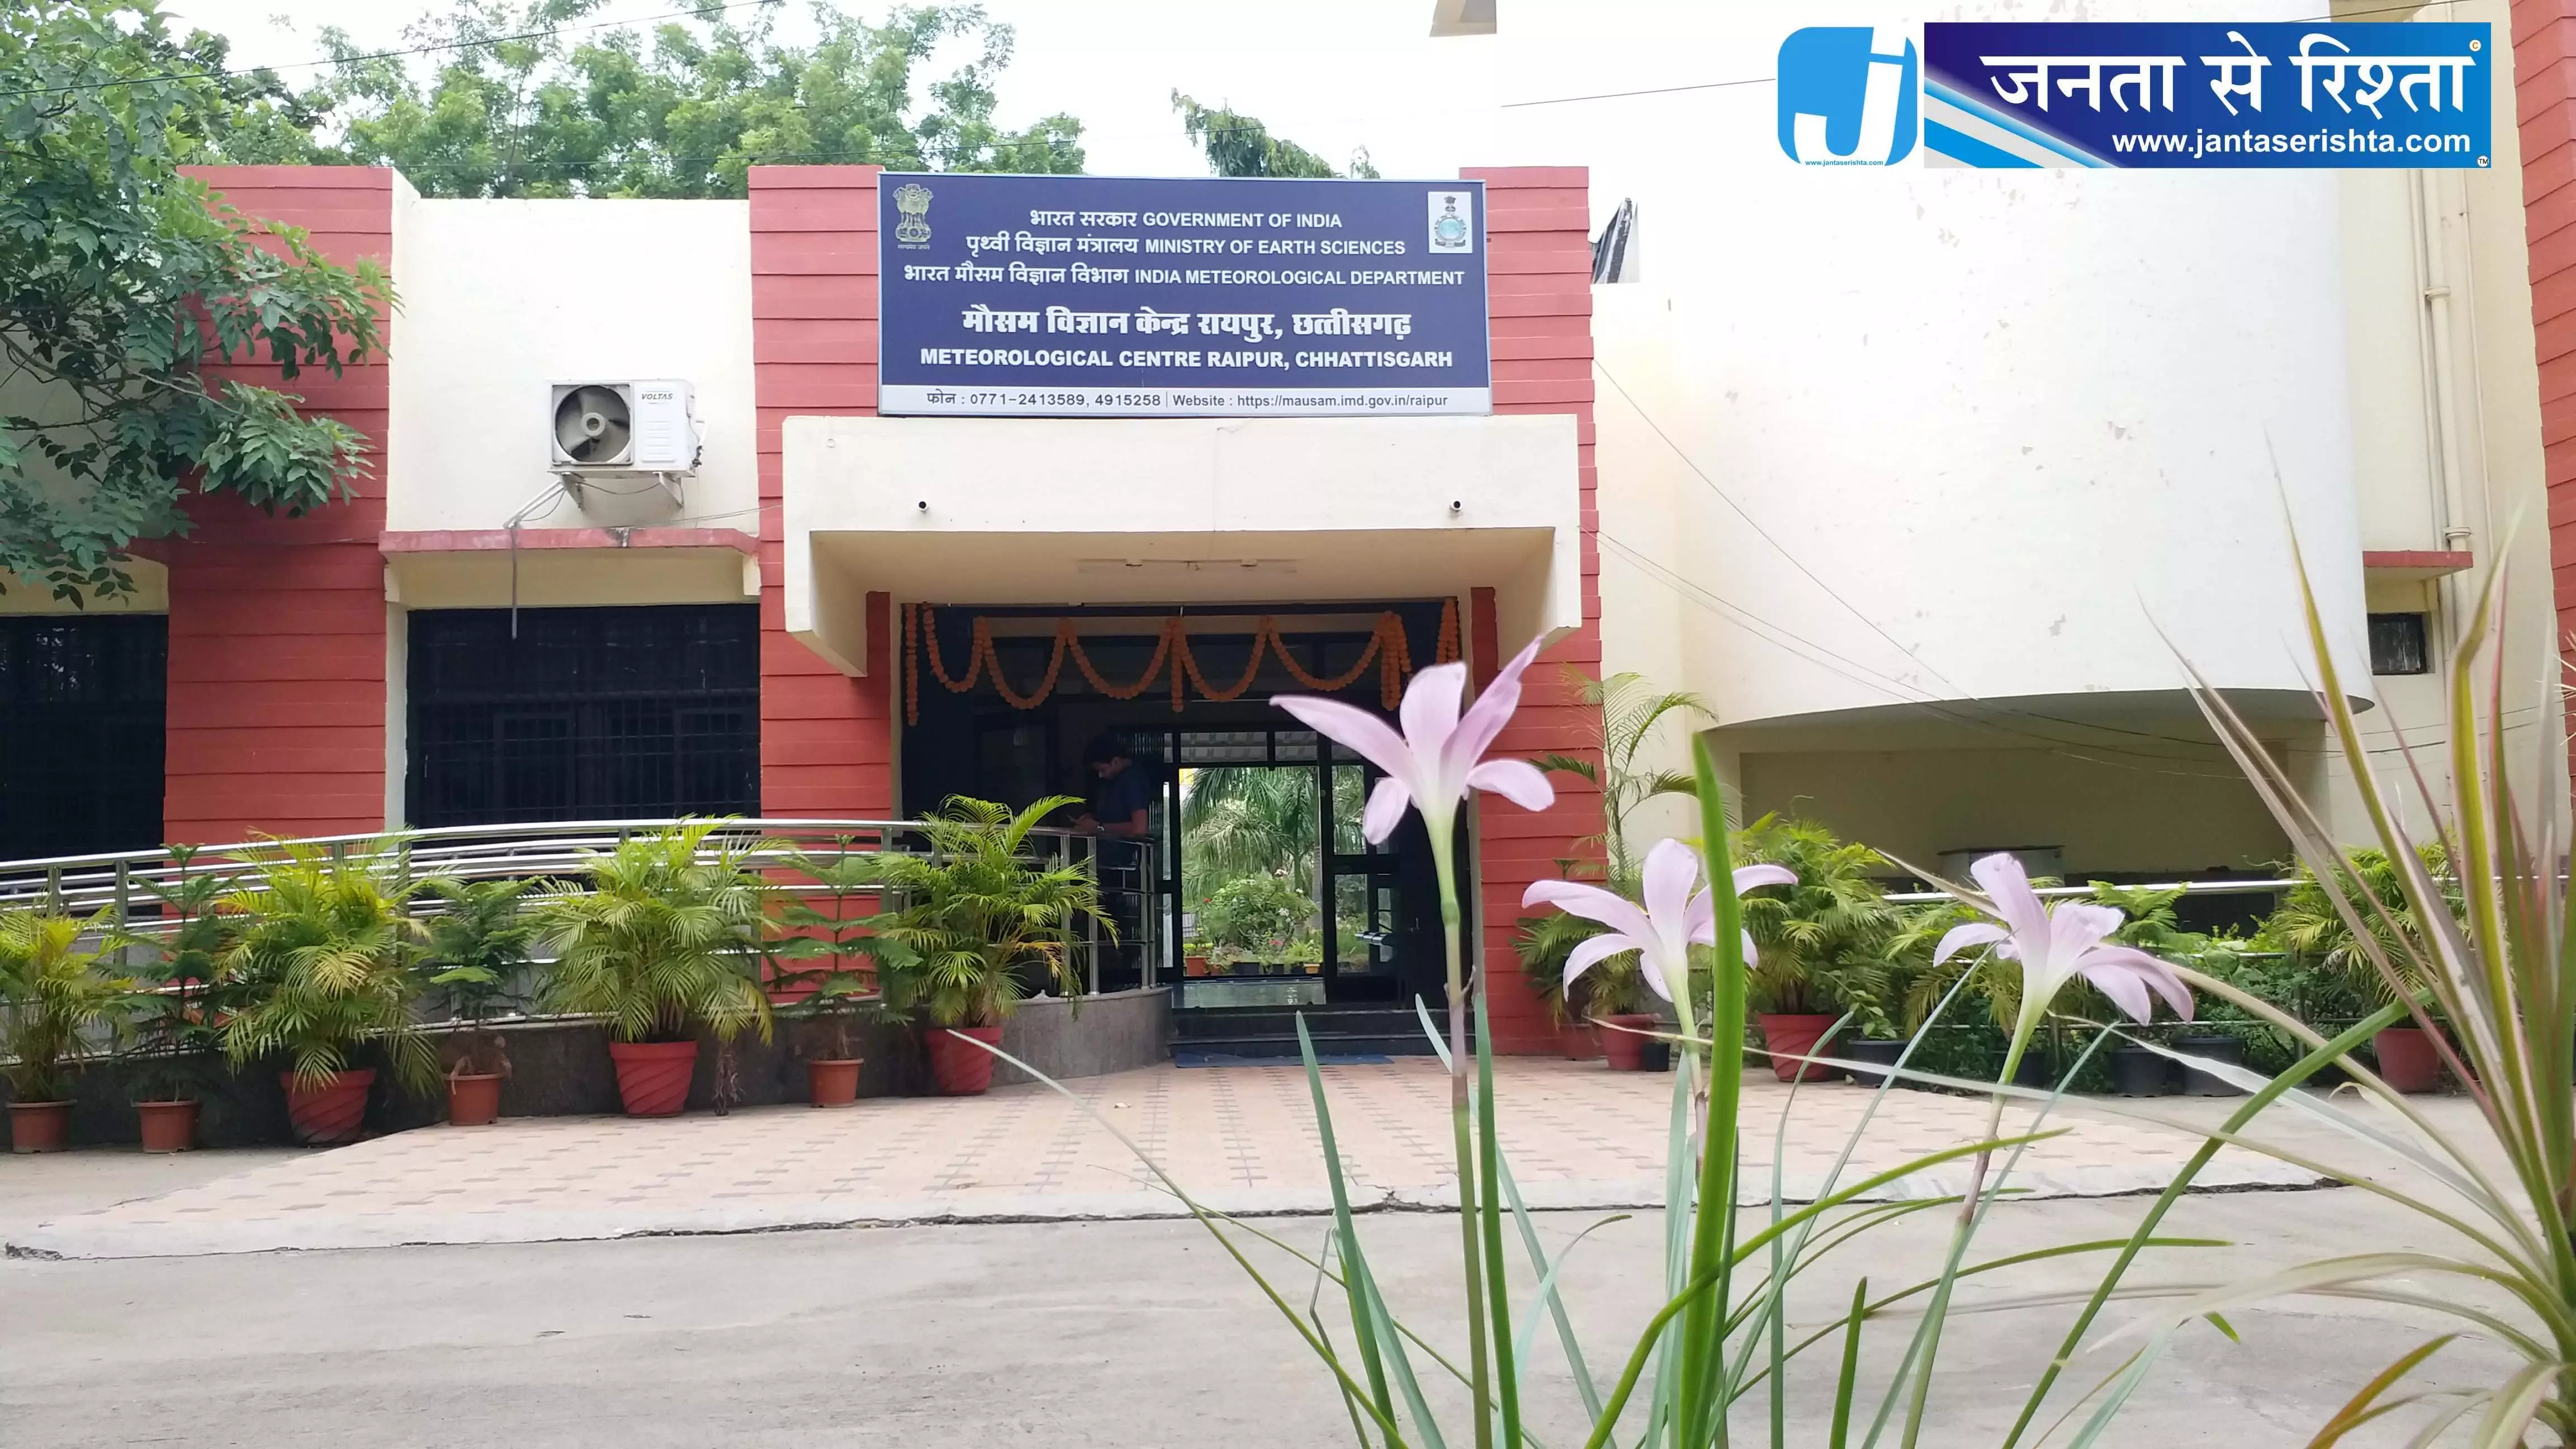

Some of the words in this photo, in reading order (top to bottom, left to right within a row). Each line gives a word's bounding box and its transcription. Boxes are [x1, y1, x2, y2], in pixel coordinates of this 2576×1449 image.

[1030, 210, 1076, 226] भारत
[1079, 211, 1138, 227] सरकार
[1143, 212, 1265, 227] GOVERNMENT
[1268, 213, 1292, 228] OF
[1296, 214, 1342, 228] INDIA
[965, 230, 1011, 258] पृथ्वी
[1014, 230, 1073, 255] विज्ञान
[1076, 233, 1139, 253] मंत्रालय
[1145, 239, 1226, 254] MINISTRY
[1230, 239, 1253, 254] OF
[1258, 240, 1315, 254] EARTH
[1320, 240, 1405, 255] SCIENCES
[904, 264, 951, 281] भारत
[954, 260, 1005, 282] मौसम
[1008, 261, 1067, 286] विज्ञान
[1070, 262, 1130, 284] विभाग
[1135, 269, 1182, 283] INDIA
[1185, 269, 1347, 285] METEOROLOGICAL
[1350, 271, 1465, 285] DEPARTMENT
[962, 304, 1040, 333] मौसम
[1045, 306, 1131, 334] विज्ञान
[1134, 306, 1191, 335] केन्द्र
[1196, 314, 1283, 343] रायपुर,
[1291, 307, 1412, 340] छत्तीसगढ़
[921, 348, 1114, 366] METEOROLOGICAL
[1119, 351, 1201, 367] CENTRE
[1208, 351, 1290, 371] RAIPUR,
[1295, 351, 1452, 367] CHHATTISGARH
[926, 388, 957, 404] फोन
[970, 393, 1090, 408] 0771-2413589,
[1095, 394, 1161, 406] 4915258
[1172, 395, 1225, 406] Website
[1237, 394, 1448, 409] https://mausam.imd.gov.in/raipur
